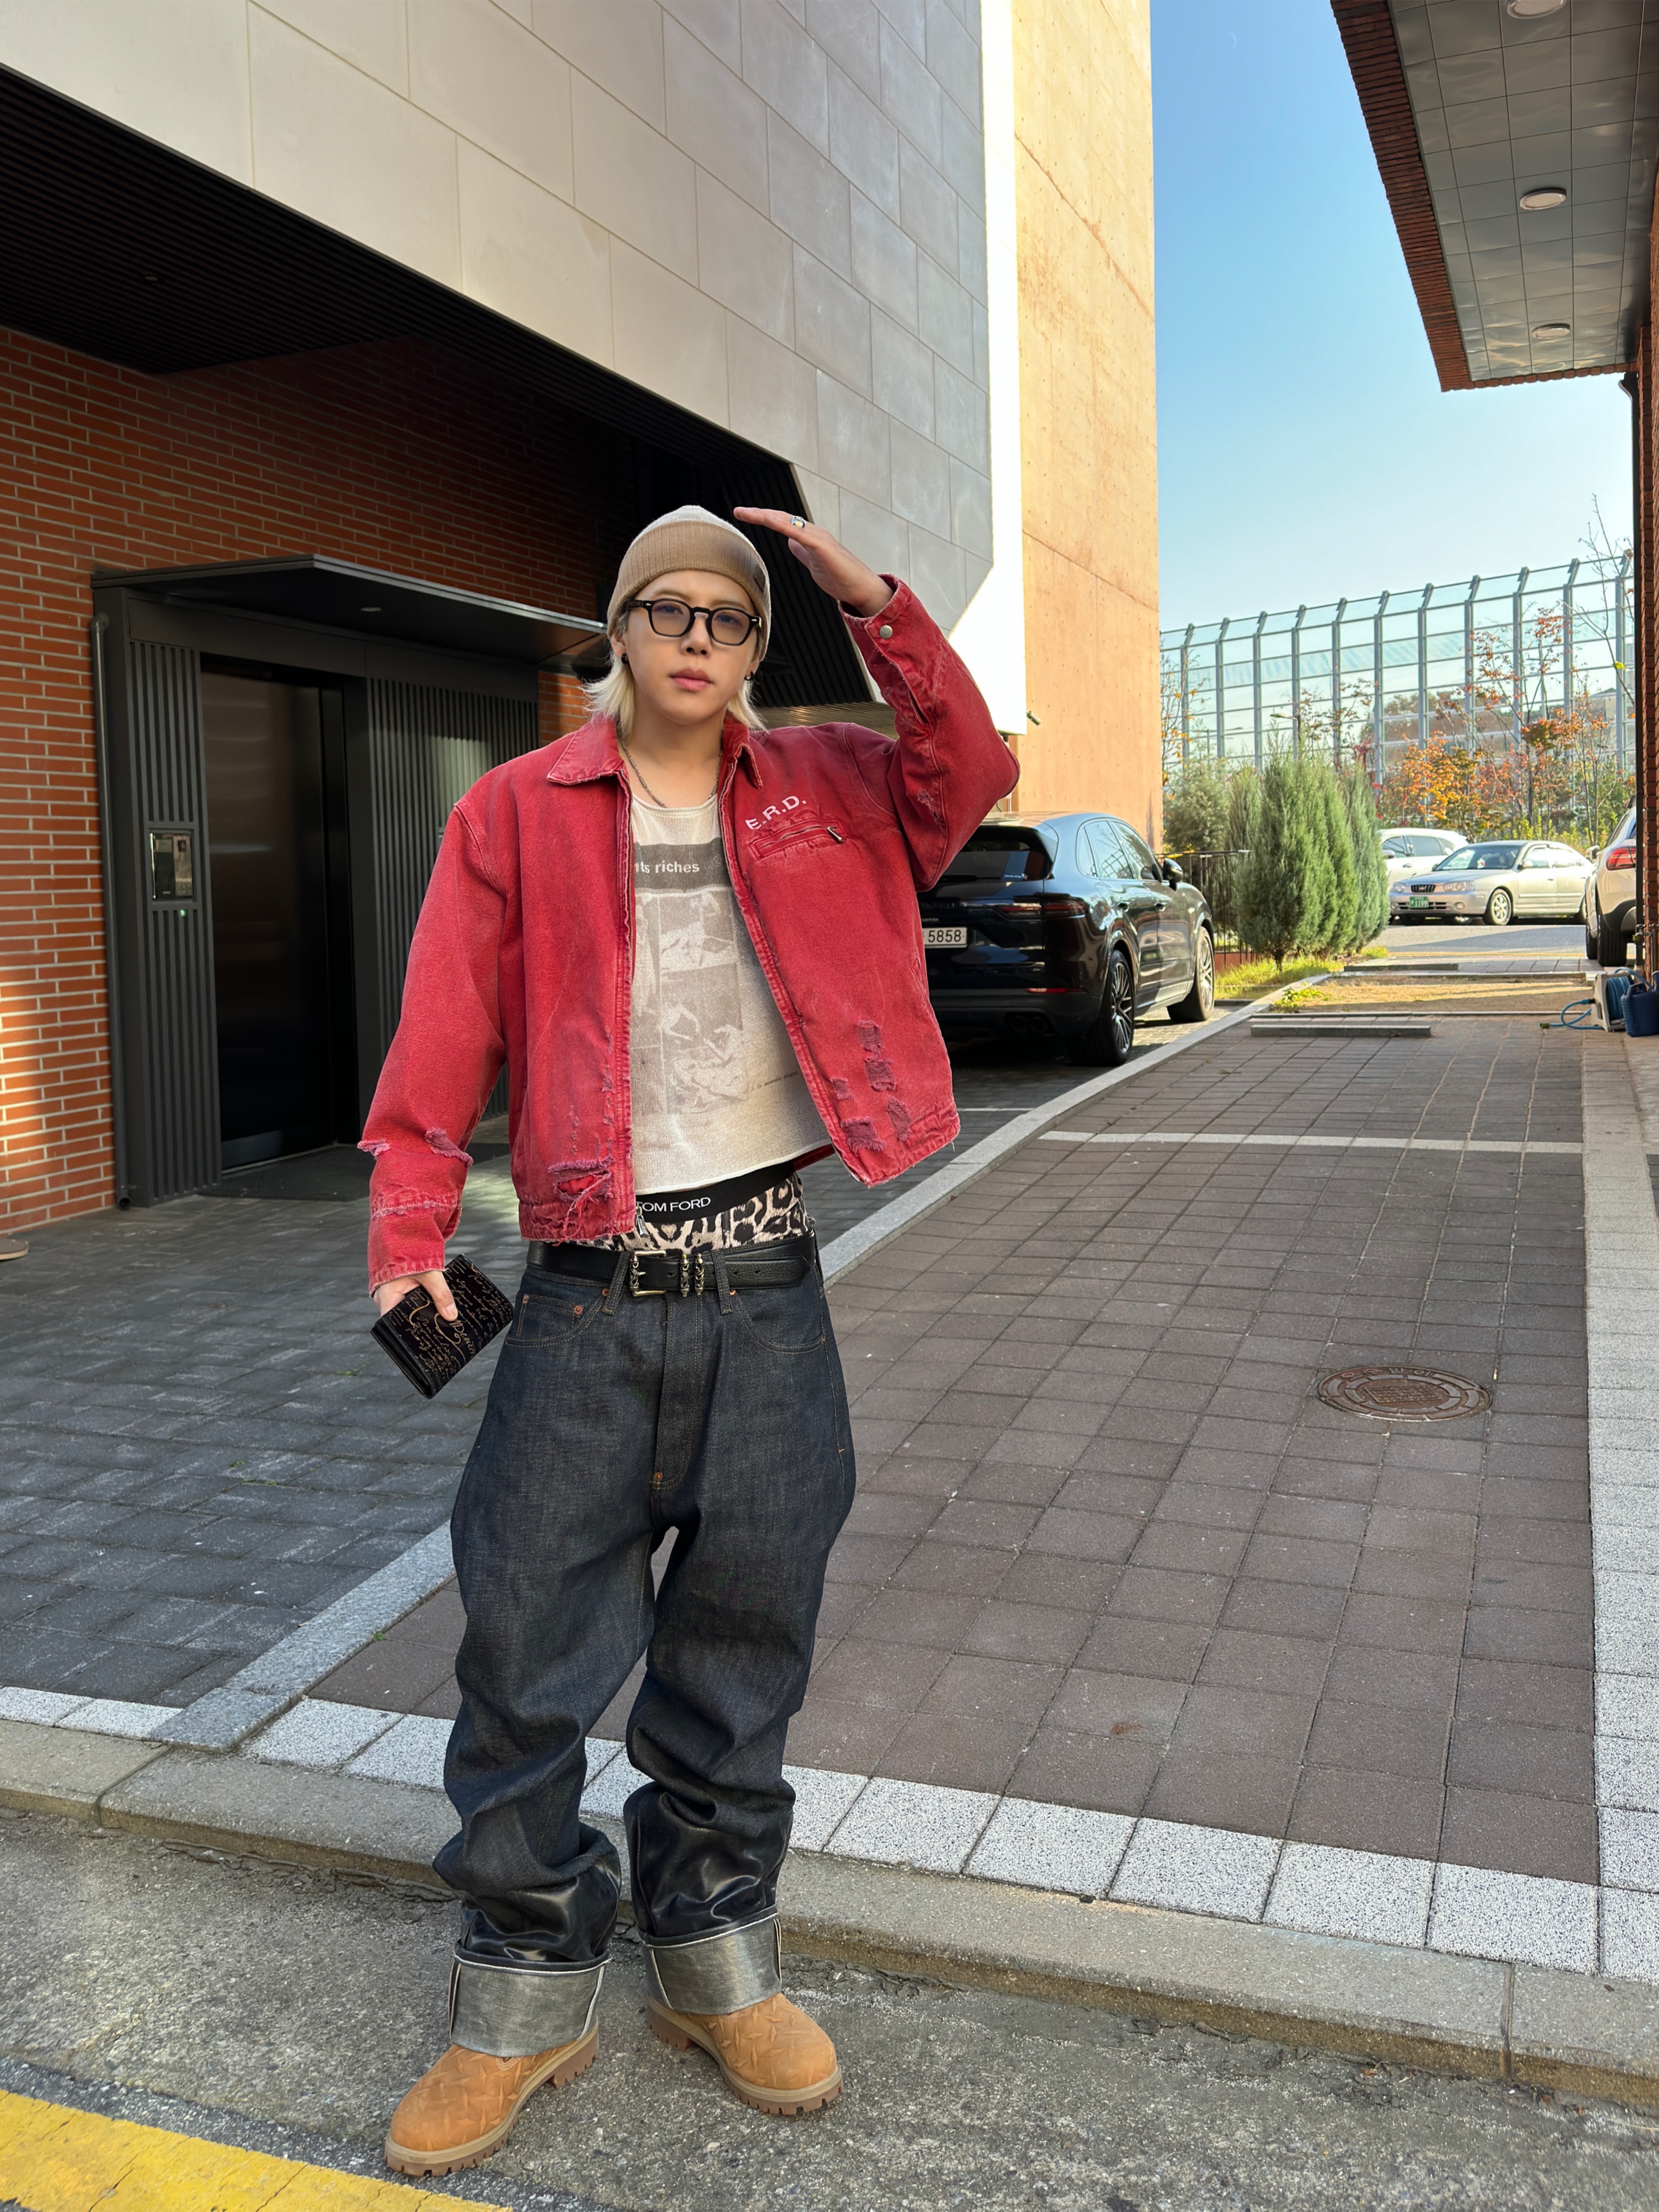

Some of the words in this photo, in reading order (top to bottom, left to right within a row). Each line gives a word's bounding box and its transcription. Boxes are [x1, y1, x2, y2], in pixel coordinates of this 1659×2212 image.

[745, 796, 807, 830] E.R.D.
[655, 860, 700, 873] riches
[928, 930, 961, 943] 5858
[670, 1197, 711, 1212] FORD
